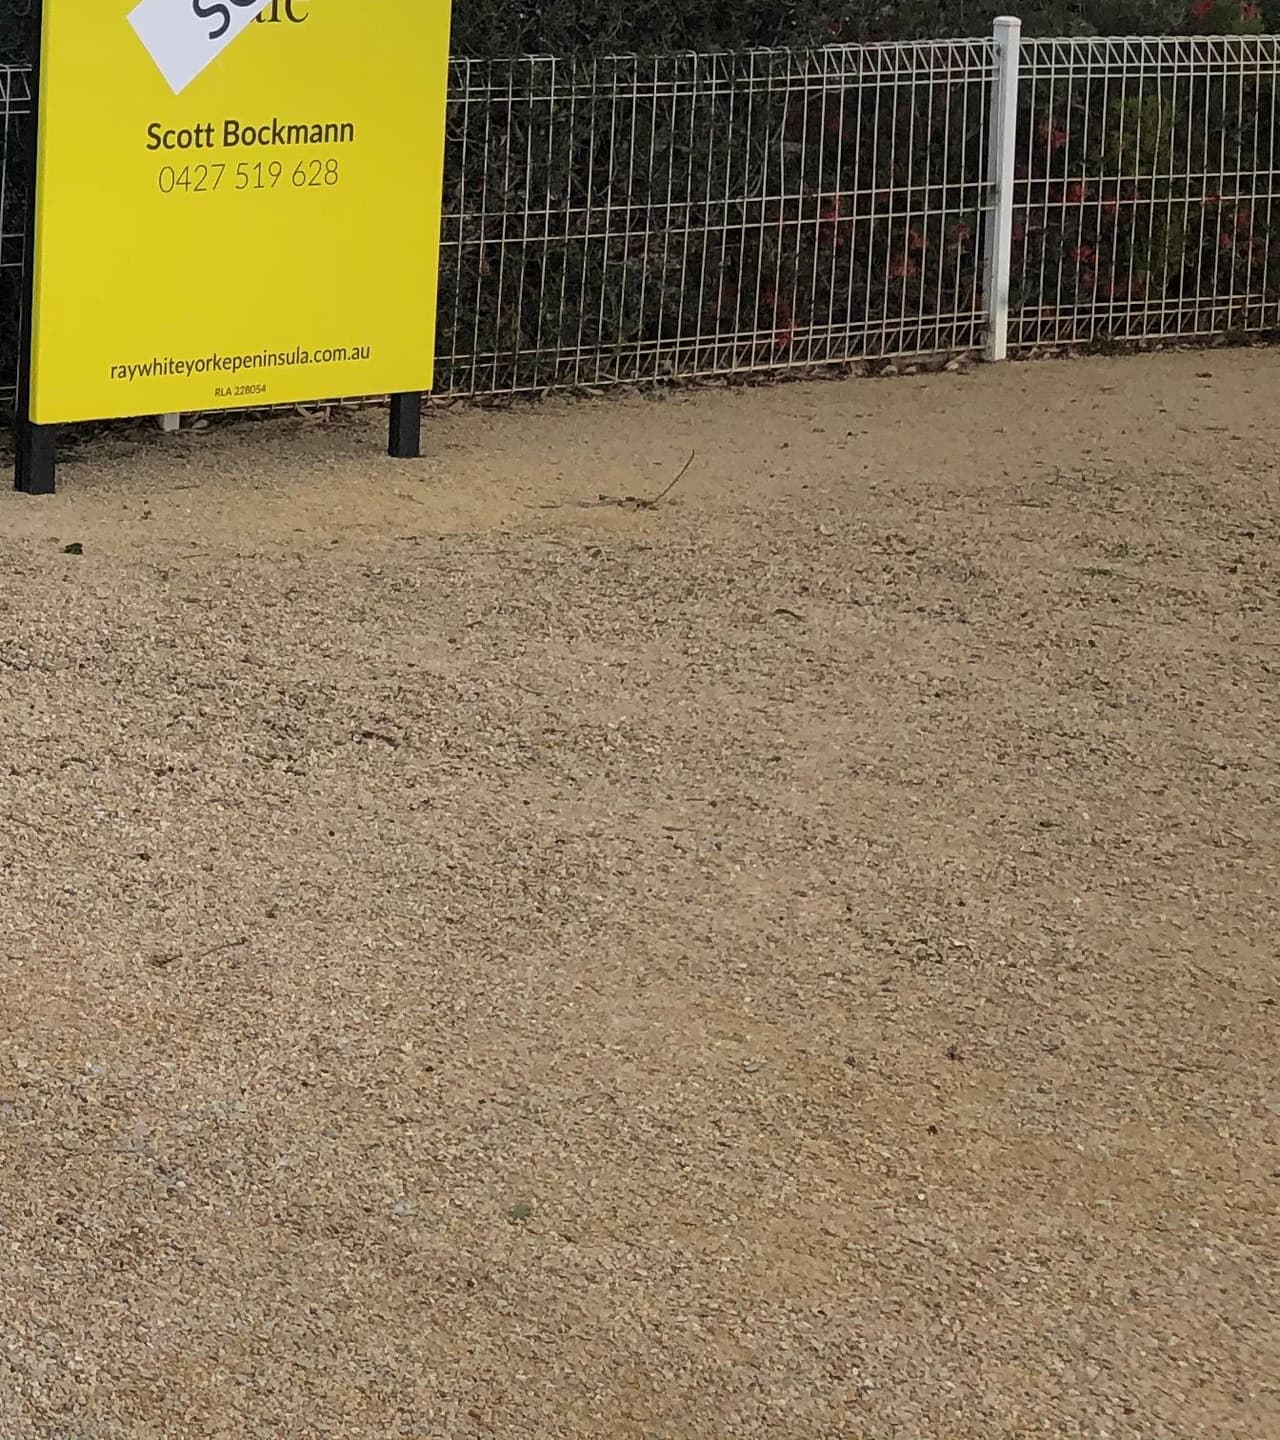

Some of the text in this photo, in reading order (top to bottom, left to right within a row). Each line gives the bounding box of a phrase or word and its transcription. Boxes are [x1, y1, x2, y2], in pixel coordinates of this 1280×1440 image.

[145, 117, 355, 151] Scott Bockmann
[158, 158, 339, 194] 0427 519 628
[110, 345, 371, 382] raywhiteyorkepeninsula.com.au
[214, 386, 233, 398] RLA
